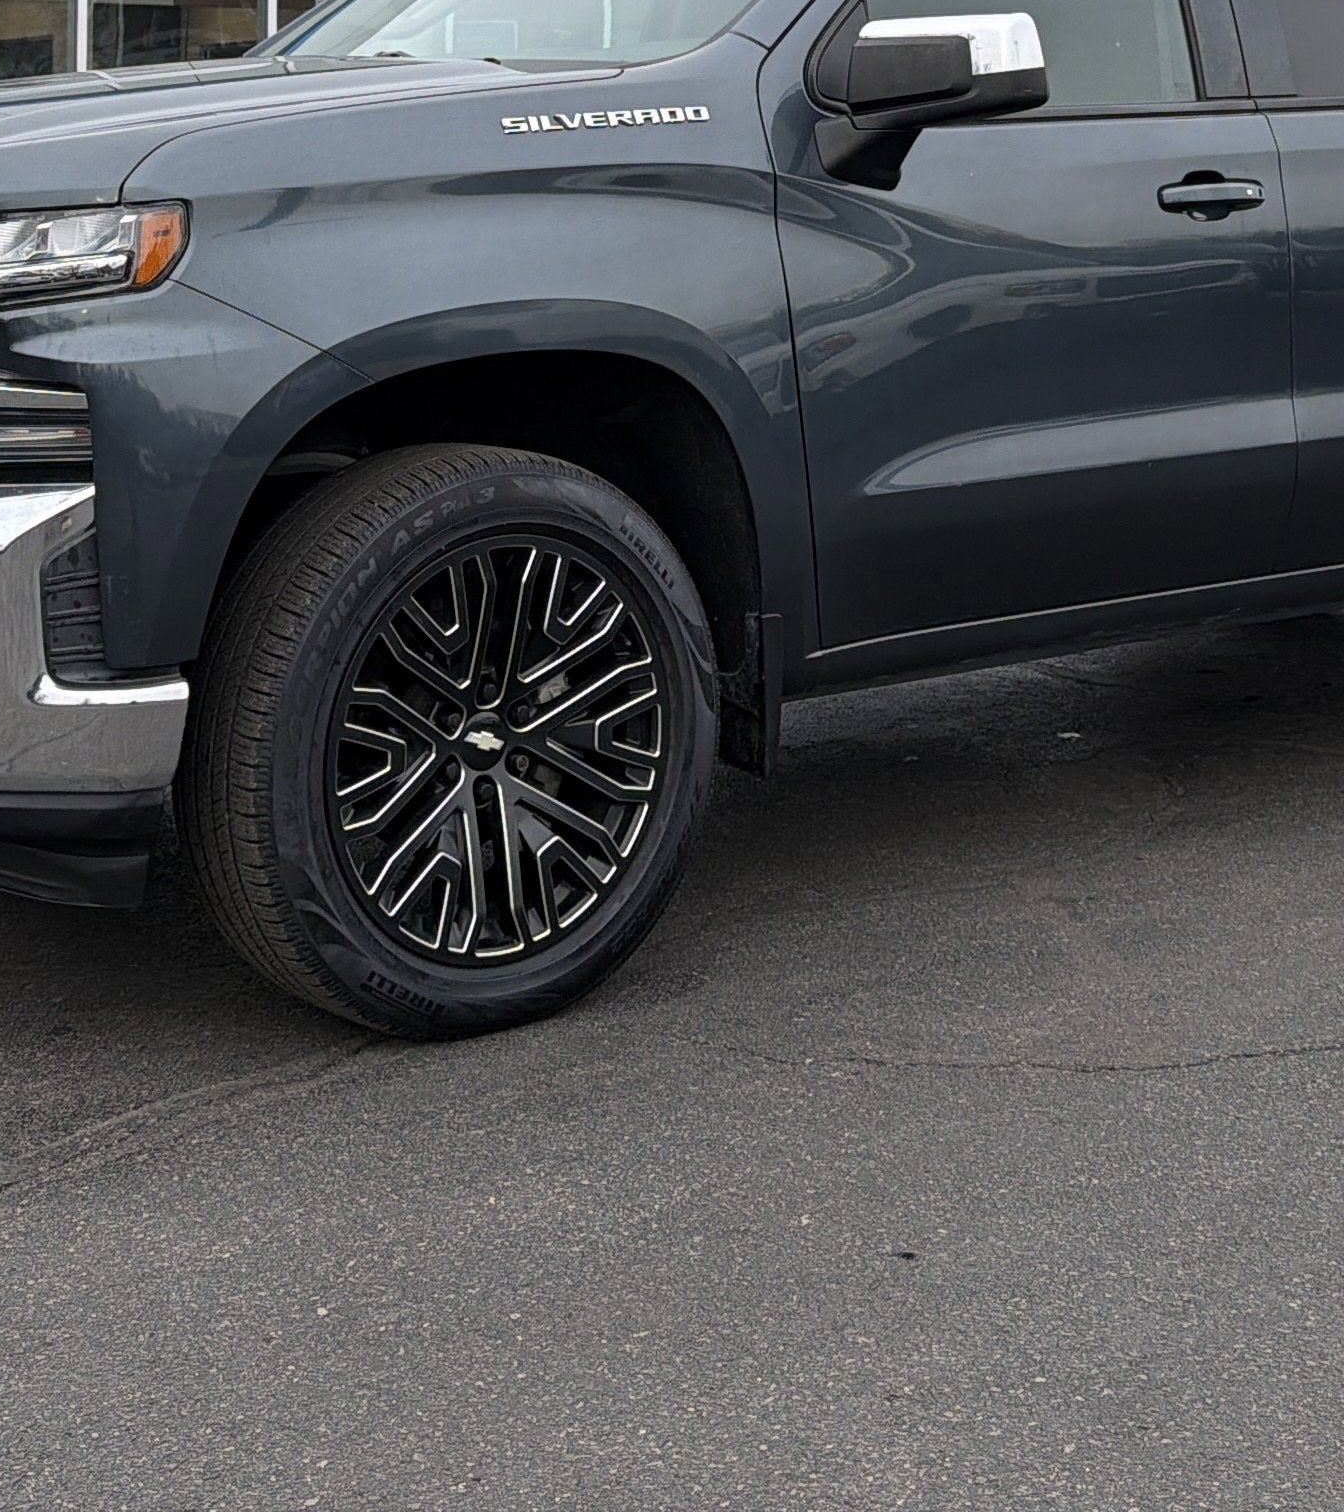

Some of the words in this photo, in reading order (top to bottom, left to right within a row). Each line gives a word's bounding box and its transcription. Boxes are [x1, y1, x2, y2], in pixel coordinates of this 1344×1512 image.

[500, 106, 710, 135] SILVERADO
[476, 487, 496, 505] 3
[618, 516, 674, 591] PIRELLI
